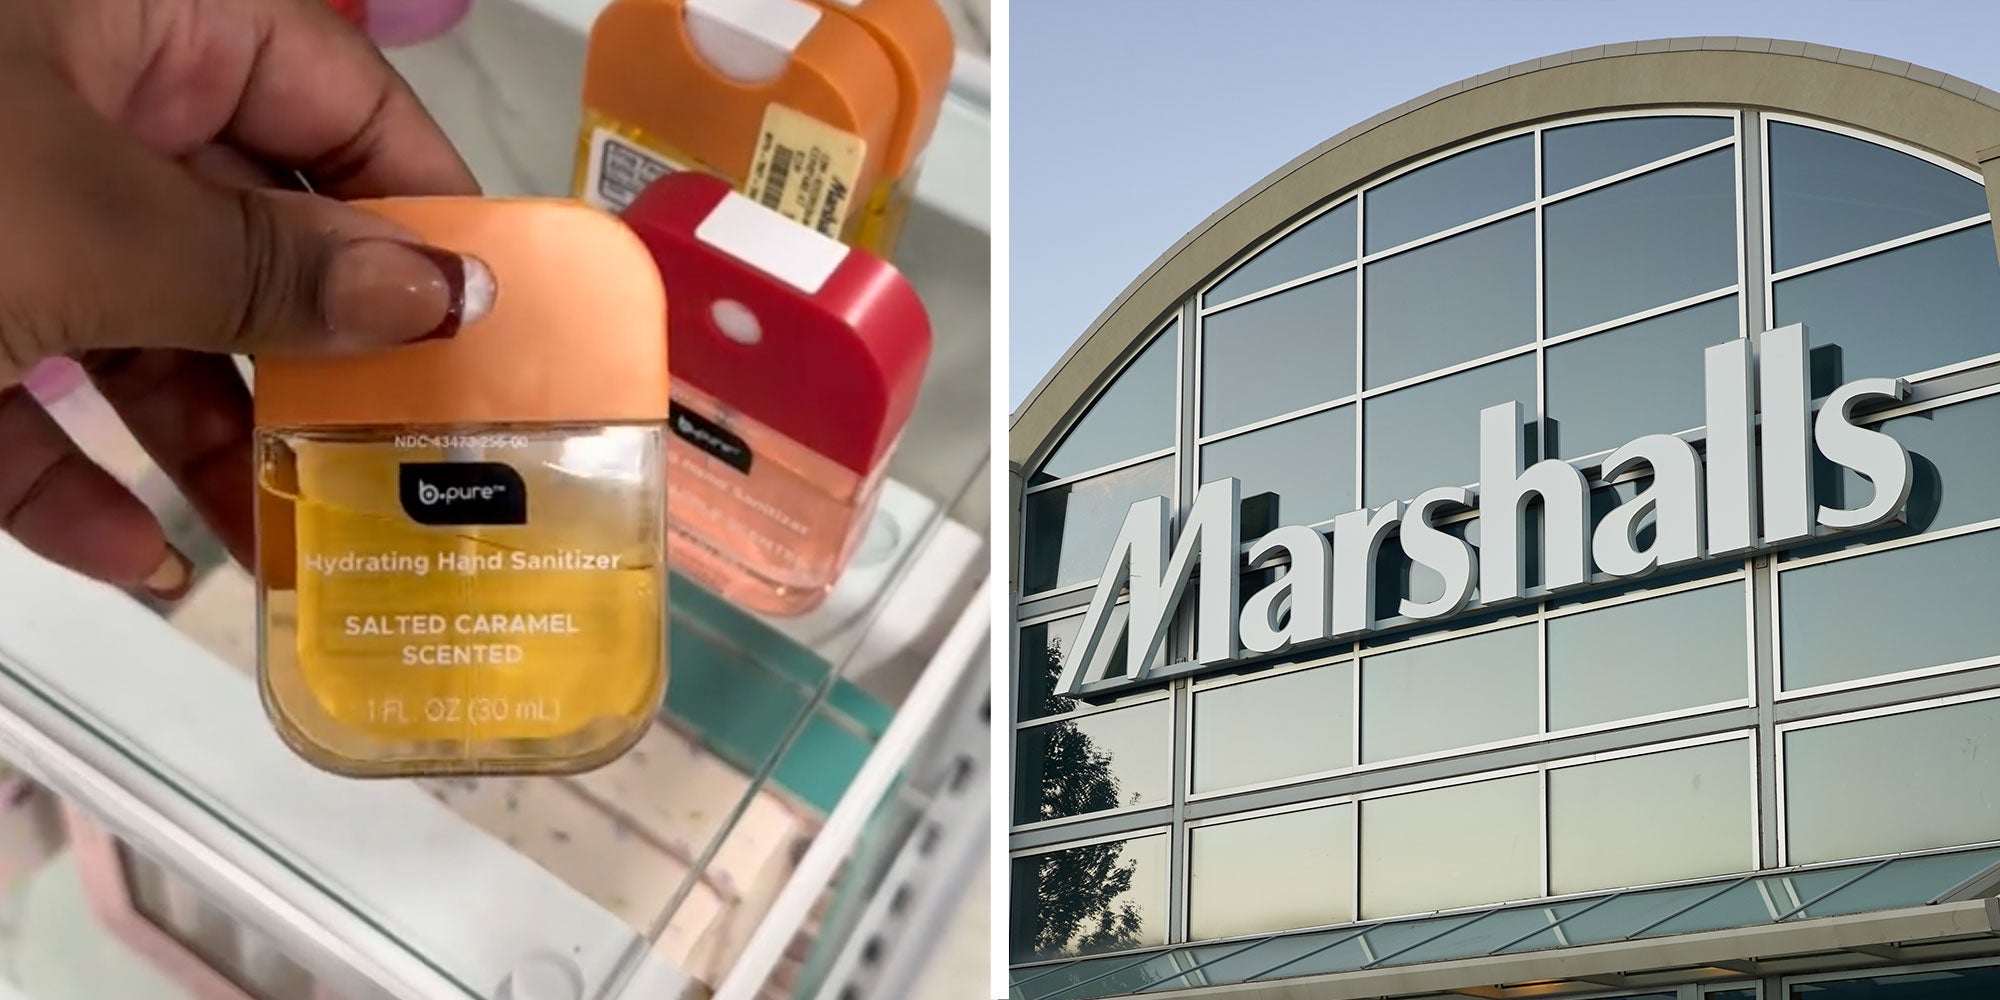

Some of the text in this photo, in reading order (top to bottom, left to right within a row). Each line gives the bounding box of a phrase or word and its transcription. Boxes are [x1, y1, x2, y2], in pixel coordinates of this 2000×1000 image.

[394, 434, 427, 449] NDC
[1054, 322, 1912, 698] Marshalls
[305, 549, 622, 576] Hydrating Hand Sanitizer
[345, 613, 580, 636] SALTED CARAMEL
[402, 645, 523, 666] SCENTED
[425, 698, 461, 722] OZ
[468, 698, 508, 725] (30
[515, 699, 561, 724] mL)
